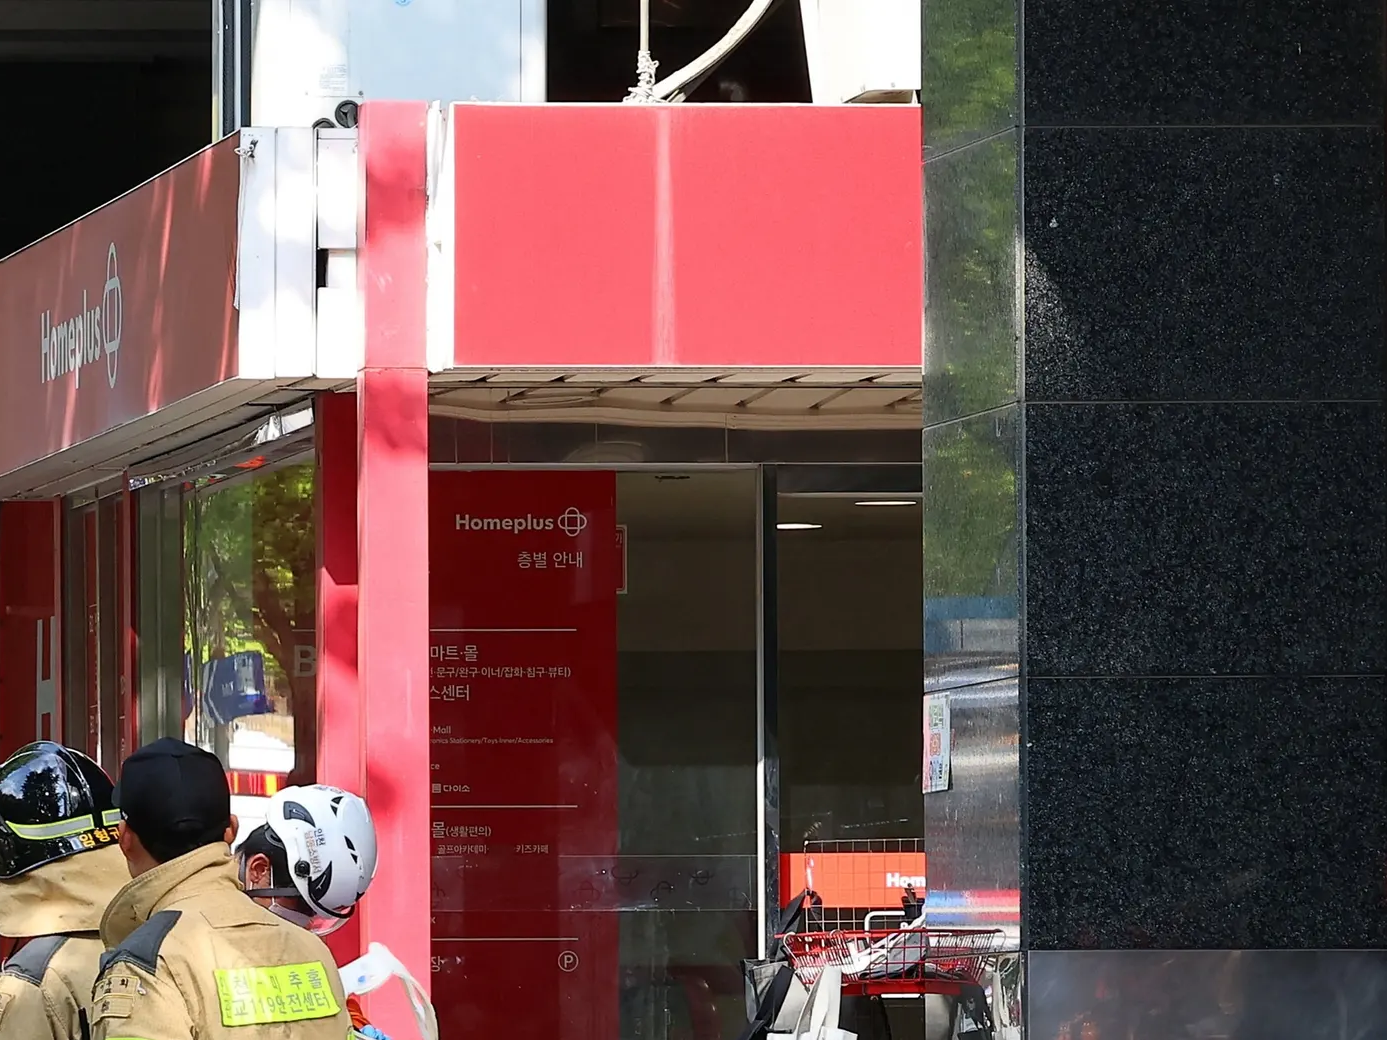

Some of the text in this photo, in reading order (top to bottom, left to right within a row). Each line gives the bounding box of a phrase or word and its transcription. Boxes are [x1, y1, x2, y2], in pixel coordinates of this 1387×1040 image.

[41, 289, 101, 389] Homeplus
[455, 513, 554, 534] Homeplus
[517, 551, 583, 568] 층별 안내
[443, 784, 471, 793] 다이소
